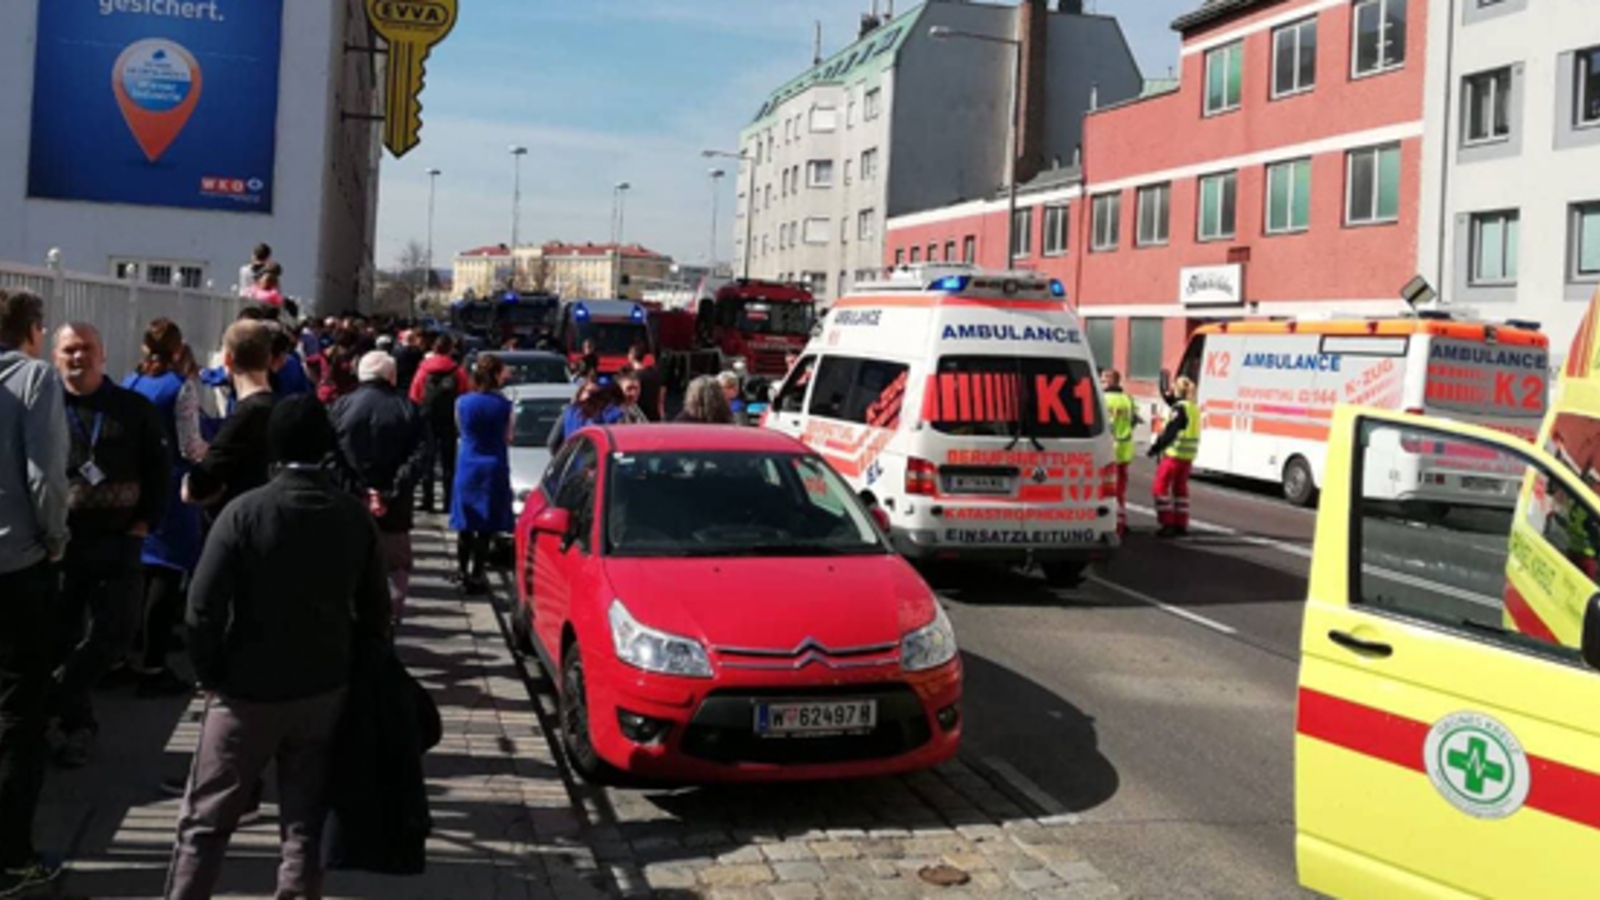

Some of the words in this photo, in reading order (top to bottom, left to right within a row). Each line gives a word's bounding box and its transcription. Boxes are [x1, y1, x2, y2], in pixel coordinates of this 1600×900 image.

[98, 0, 225, 21] gesichert.
[381, 3, 440, 21] EVVA
[201, 177, 244, 192] WKO
[942, 324, 1081, 343] AMBULANCE
[1205, 350, 1231, 378] K2
[1242, 353, 1341, 372] AMBULANCE
[1430, 344, 1547, 370] AMBULANCE
[1035, 374, 1095, 425] K1
[1494, 371, 1545, 412] K2
[947, 449, 1094, 466] BERUFSRETTUNG
[944, 507, 1097, 520] KATASTROPHENZUG
[945, 528, 1095, 543] EINSATZLEITUNG
[771, 708, 783, 727] W
[799, 704, 857, 727] 62497
